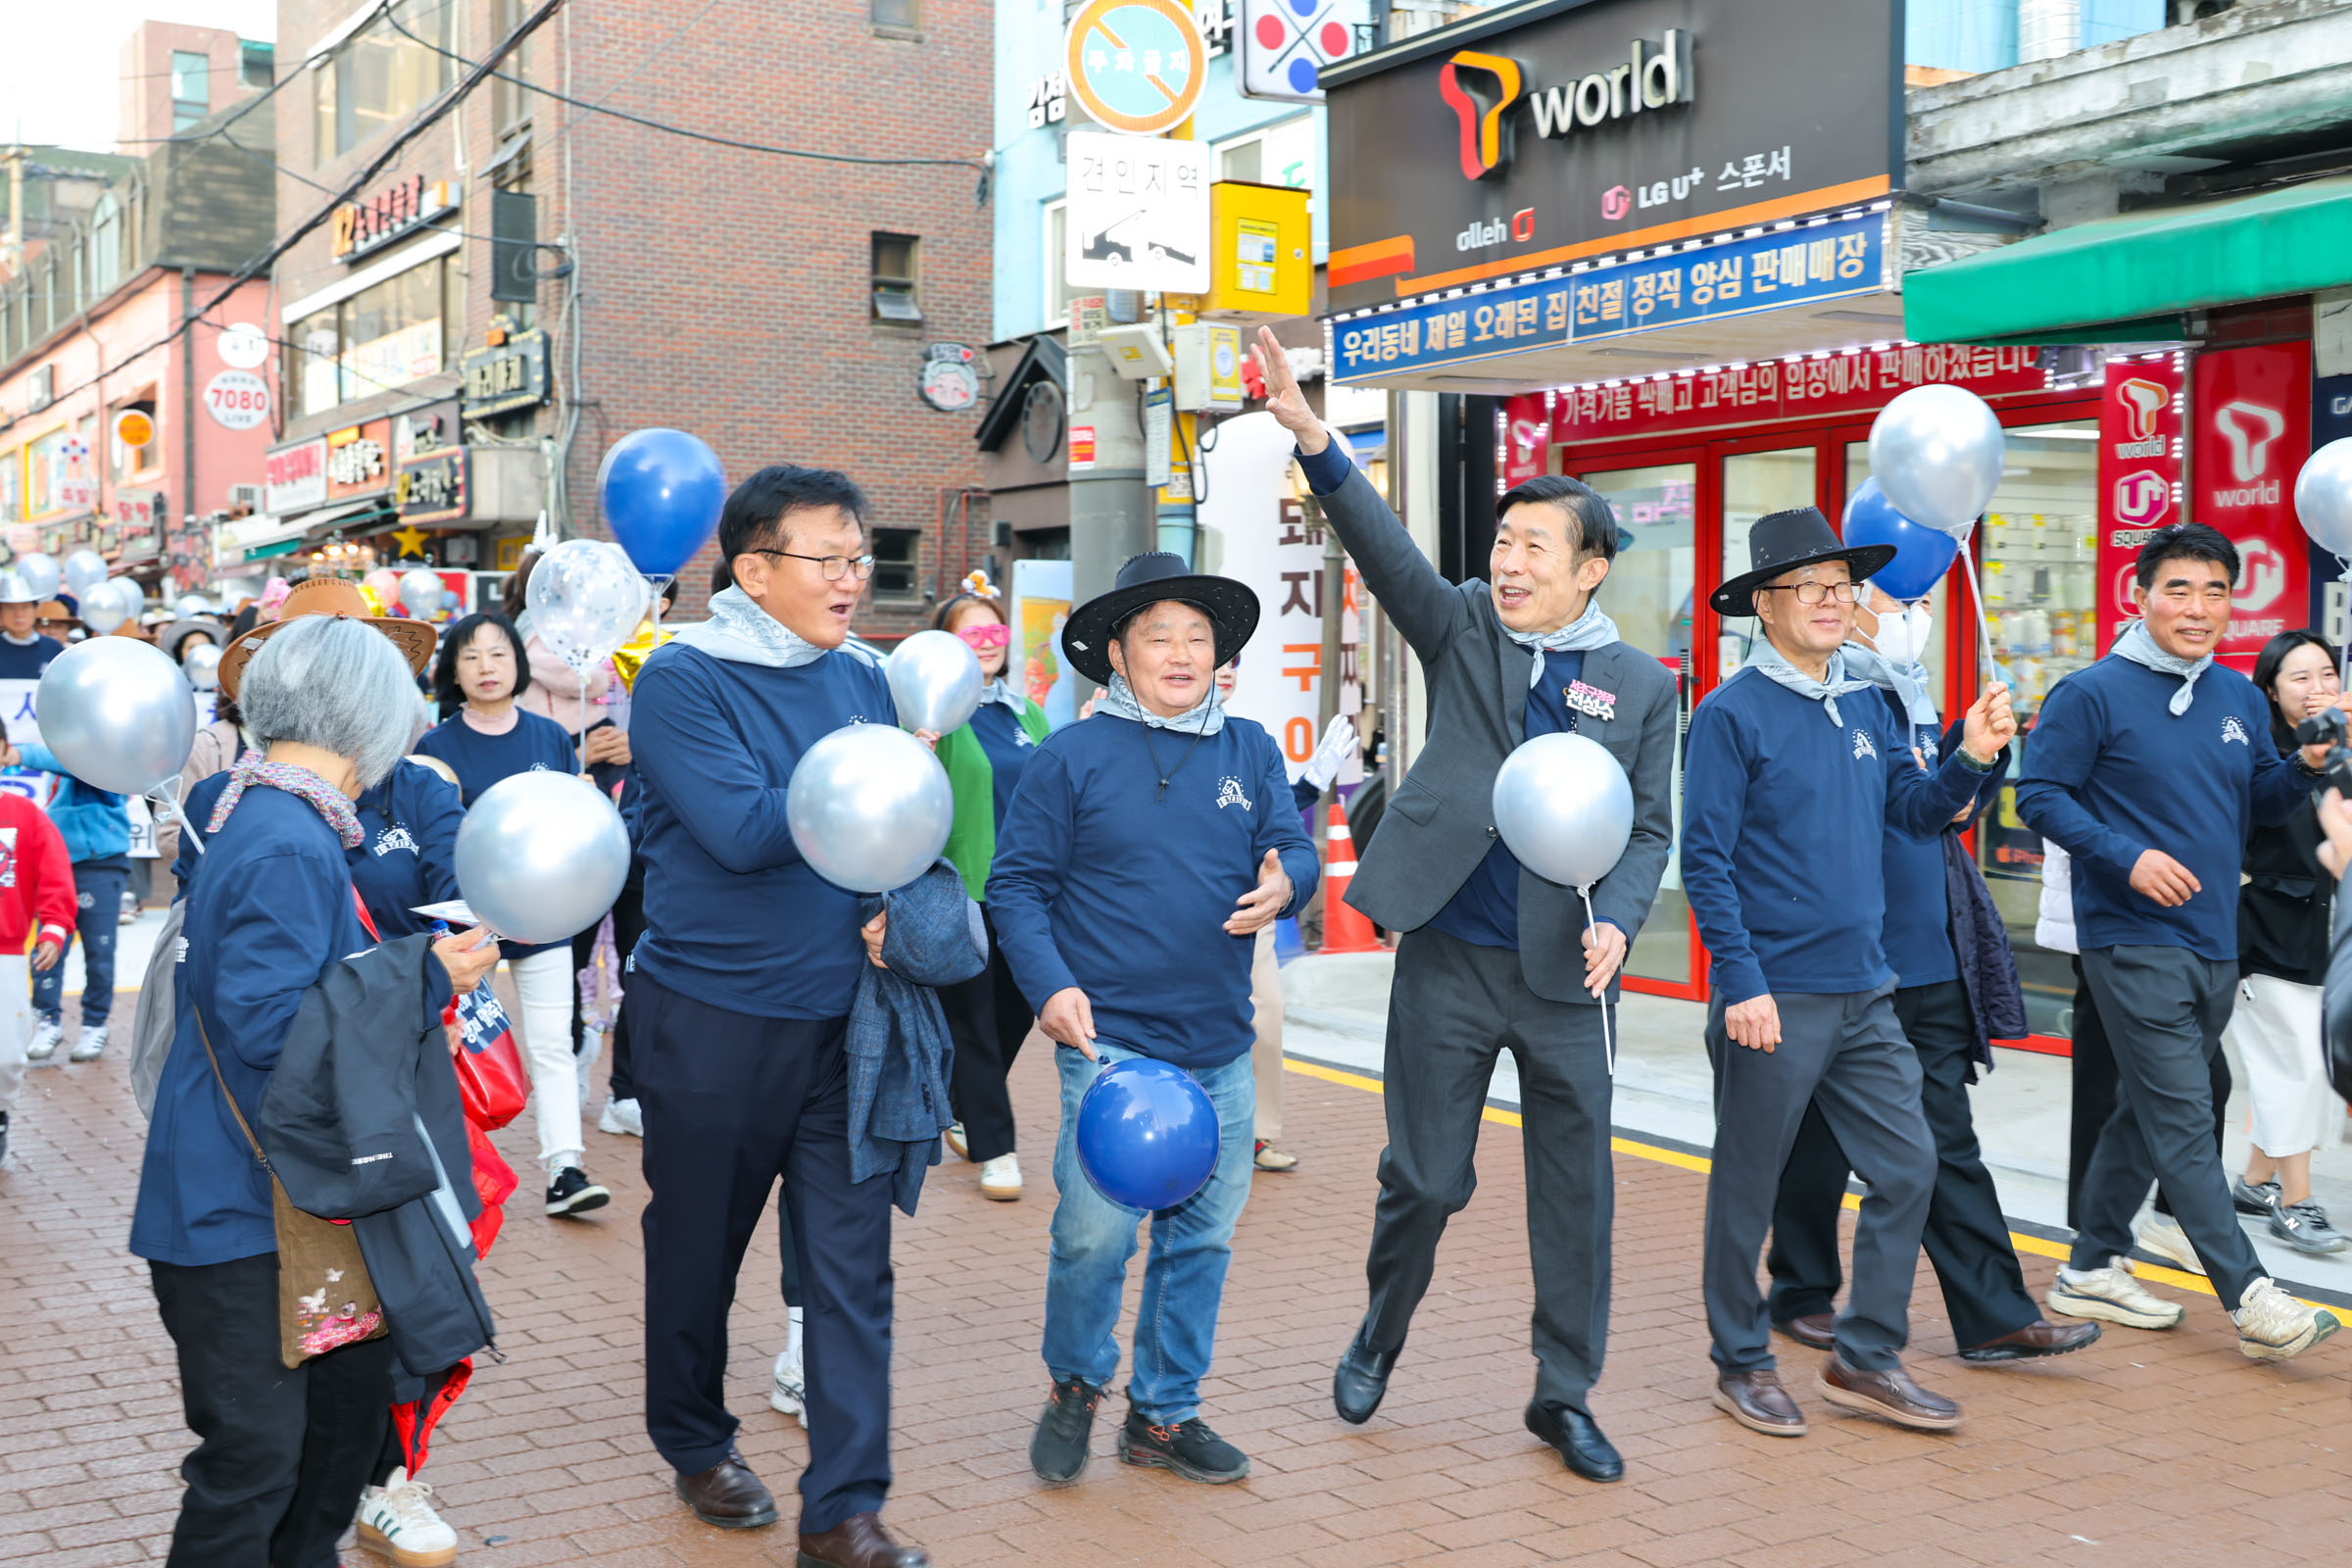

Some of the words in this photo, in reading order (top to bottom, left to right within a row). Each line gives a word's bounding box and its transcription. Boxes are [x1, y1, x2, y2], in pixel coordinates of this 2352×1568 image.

[1088, 50, 1187, 74] 주차금지
[1530, 28, 1678, 139] world
[1082, 157, 1199, 195] 견인지역
[1639, 184, 1670, 210] LG
[1716, 145, 1791, 192] 스폰서
[1456, 217, 1507, 252] olleh
[1343, 318, 1420, 367] 우리동네
[1425, 310, 1467, 352] 제일
[1473, 296, 1539, 342] 오래된
[1545, 290, 1568, 331] 집
[1576, 279, 1624, 325] 친절
[1632, 268, 1682, 316] 정직
[1690, 256, 1742, 306] 양심
[1751, 231, 1868, 294] 판매매장
[211, 388, 267, 412] 7080
[1562, 385, 1632, 426] 가격거품
[1698, 365, 1779, 408] 고객님의
[1786, 353, 1871, 400] 입장에서
[2116, 435, 2167, 460] world
[2215, 479, 2280, 508] world
[2223, 619, 2284, 641] QUARE
[1566, 688, 1615, 722] 전성수
[2284, 1217, 2300, 1231] N
